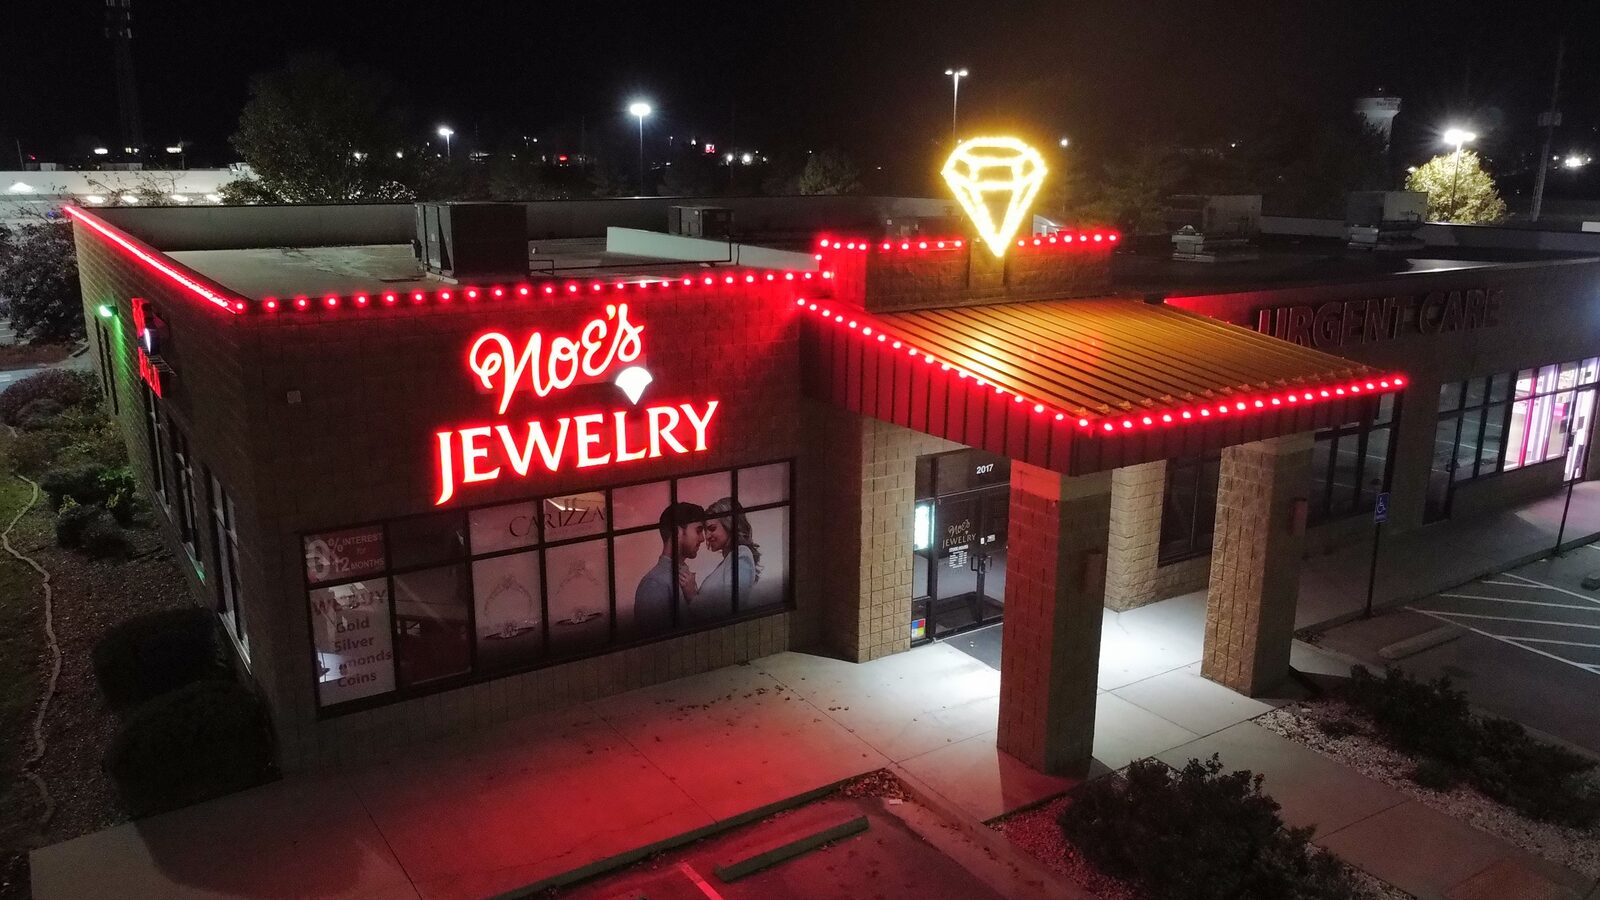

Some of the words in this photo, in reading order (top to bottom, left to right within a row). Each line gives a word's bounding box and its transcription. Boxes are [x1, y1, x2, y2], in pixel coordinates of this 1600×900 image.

[1257, 296, 1410, 347] URGENT
[1419, 287, 1505, 334] CARE
[433, 400, 720, 506] JEWELRY
[976, 463, 994, 474] 2017
[342, 532, 384, 545] INTEREST
[942, 533, 976, 549] JEWELRY
[332, 557, 351, 573] 12
[351, 557, 386, 570] MONTHS
[336, 617, 370, 634] Gold
[334, 636, 375, 652] Silver
[337, 671, 378, 688] Coins
